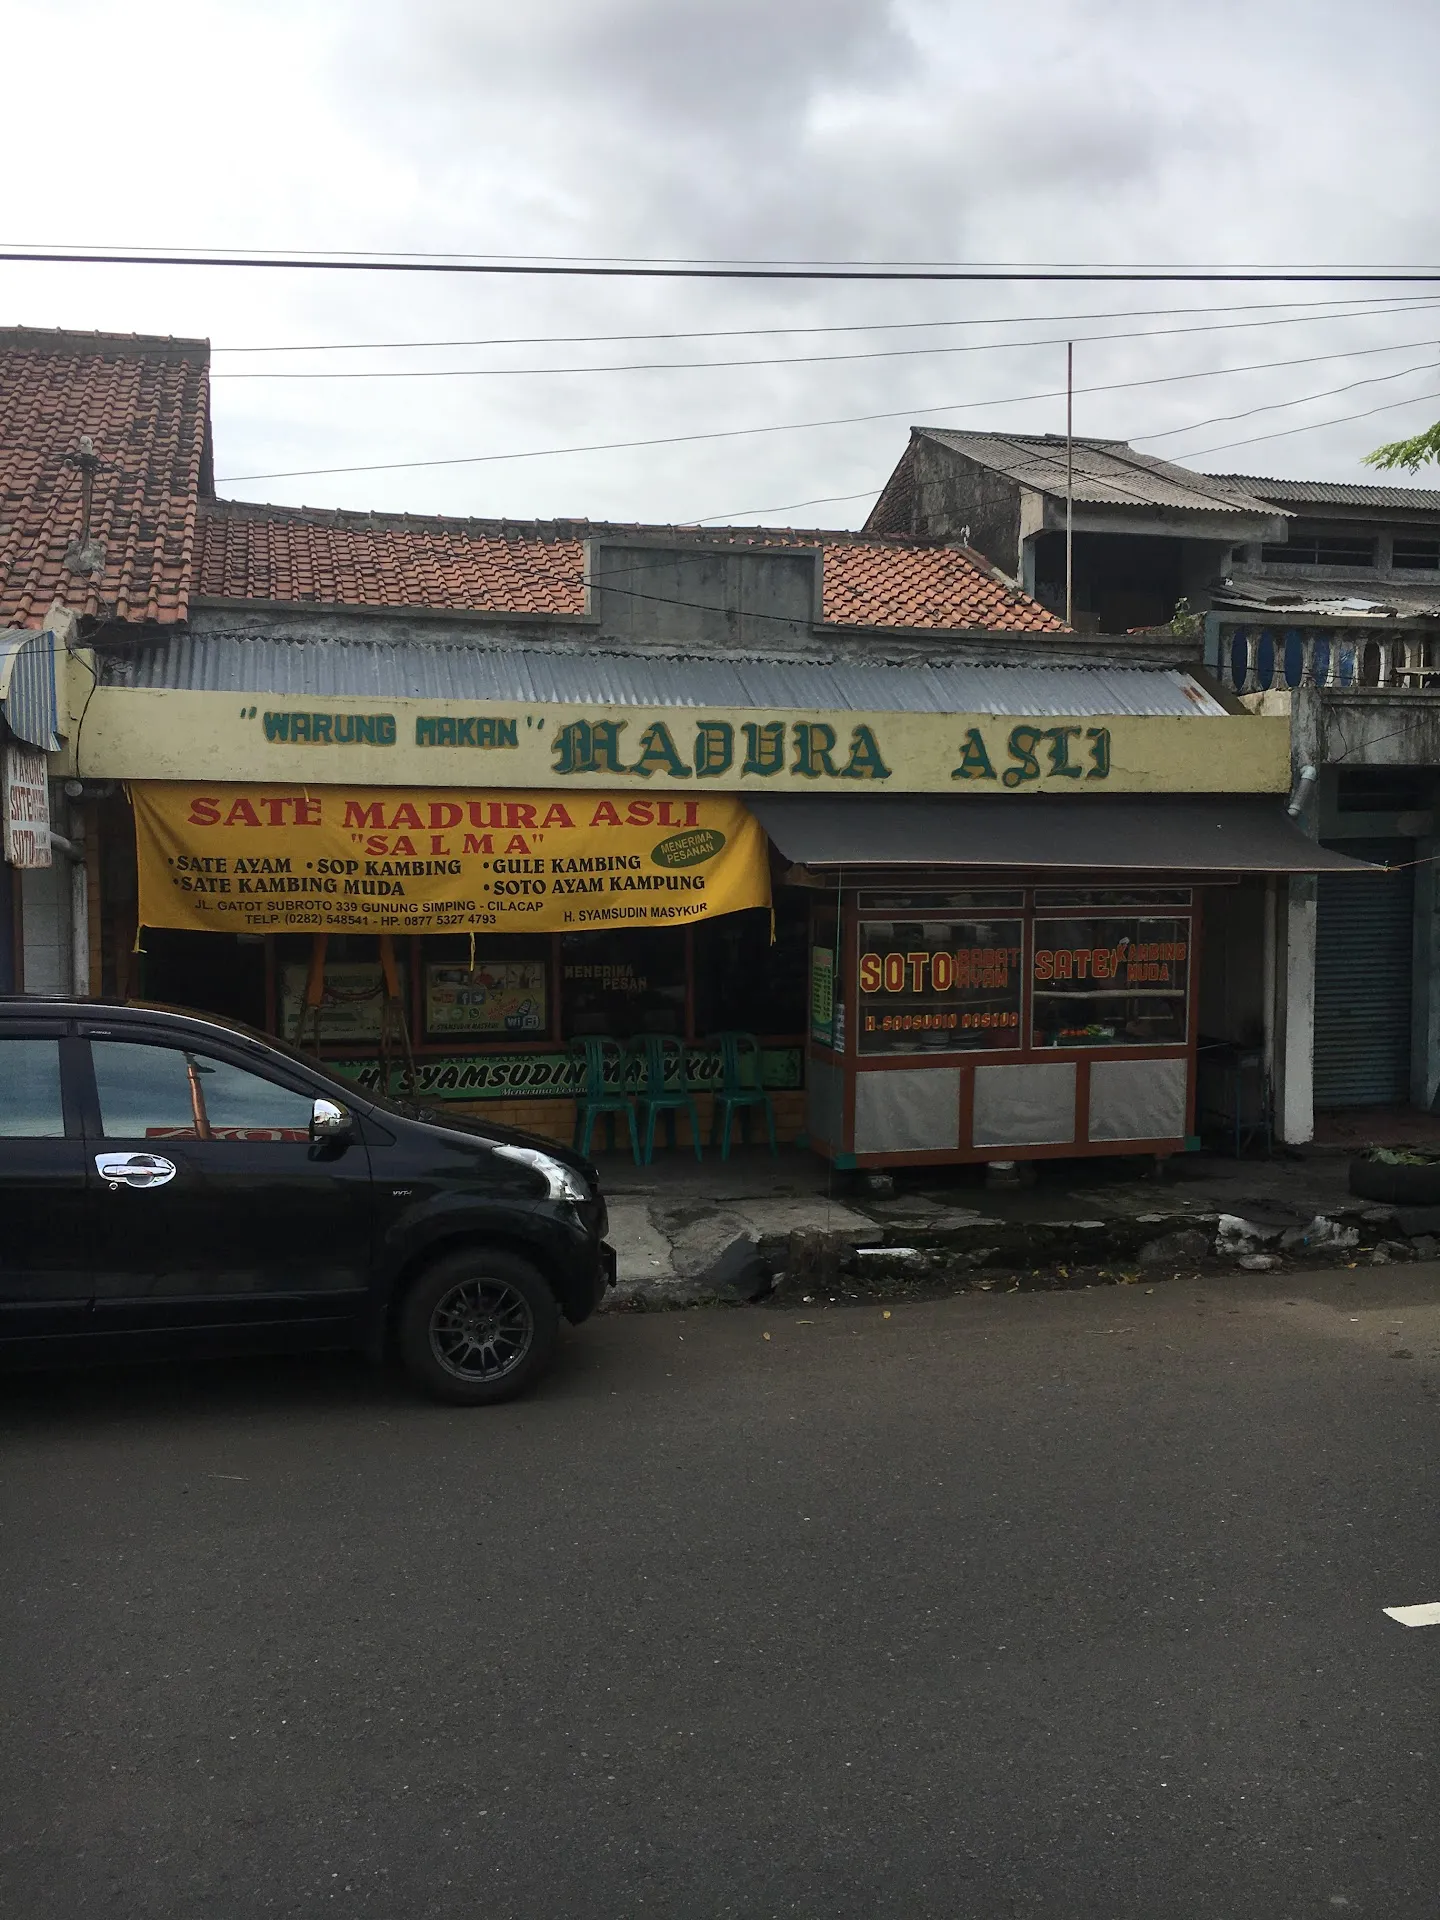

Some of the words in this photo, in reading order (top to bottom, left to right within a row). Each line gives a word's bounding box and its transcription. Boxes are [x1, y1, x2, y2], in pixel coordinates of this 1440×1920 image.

[550, 718, 893, 779] MADURA
[951, 724, 1111, 788] ASLI
[187, 797, 322, 827] SATE
[342, 801, 575, 830] MADURA
[589, 800, 699, 827] ASLI
[660, 831, 713, 854] MENERIMA
[666, 843, 714, 864] PESANAN
[176, 856, 228, 874] SATE
[233, 858, 292, 874] AYAM
[317, 859, 359, 875] SOP
[365, 859, 462, 876] KAMBING
[492, 858, 545, 875] GULE
[551, 855, 641, 873] KAMBING
[180, 876, 232, 893] SATE
[238, 877, 337, 894] KAMBING
[343, 879, 405, 896] MUDA
[493, 879, 547, 895] SOTO
[551, 878, 604, 894] AYAM
[609, 875, 705, 891] KAMPUNG
[194, 900, 213, 911] JL.
[217, 901, 261, 912] GATOT
[267, 900, 332, 912] SUBROTO
[336, 901, 358, 912] 339
[361, 902, 418, 913] GUNUNG
[422, 901, 476, 913] SIMPING
[487, 901, 544, 912] CILACAP
[563, 911, 576, 923] H.
[578, 908, 648, 923] SYAMSUDIN
[650, 902, 708, 919] MASYKUR
[245, 914, 281, 925] TELP.
[284, 913, 323, 926] (0282)
[326, 914, 369, 926] 548541
[381, 915, 400, 926] HP.
[404, 915, 432, 926] 0877
[436, 914, 464, 925] 5327
[467, 913, 496, 925] 4793
[1116, 942, 1187, 962] KAMBING
[564, 963, 634, 980] MENERIMA
[859, 951, 953, 993] SOTO
[1034, 948, 1111, 980] SATE
[1127, 962, 1170, 982] MUDA
[602, 976, 648, 992] PESAN
[397, 1060, 588, 1091] SYAMSUDIN
